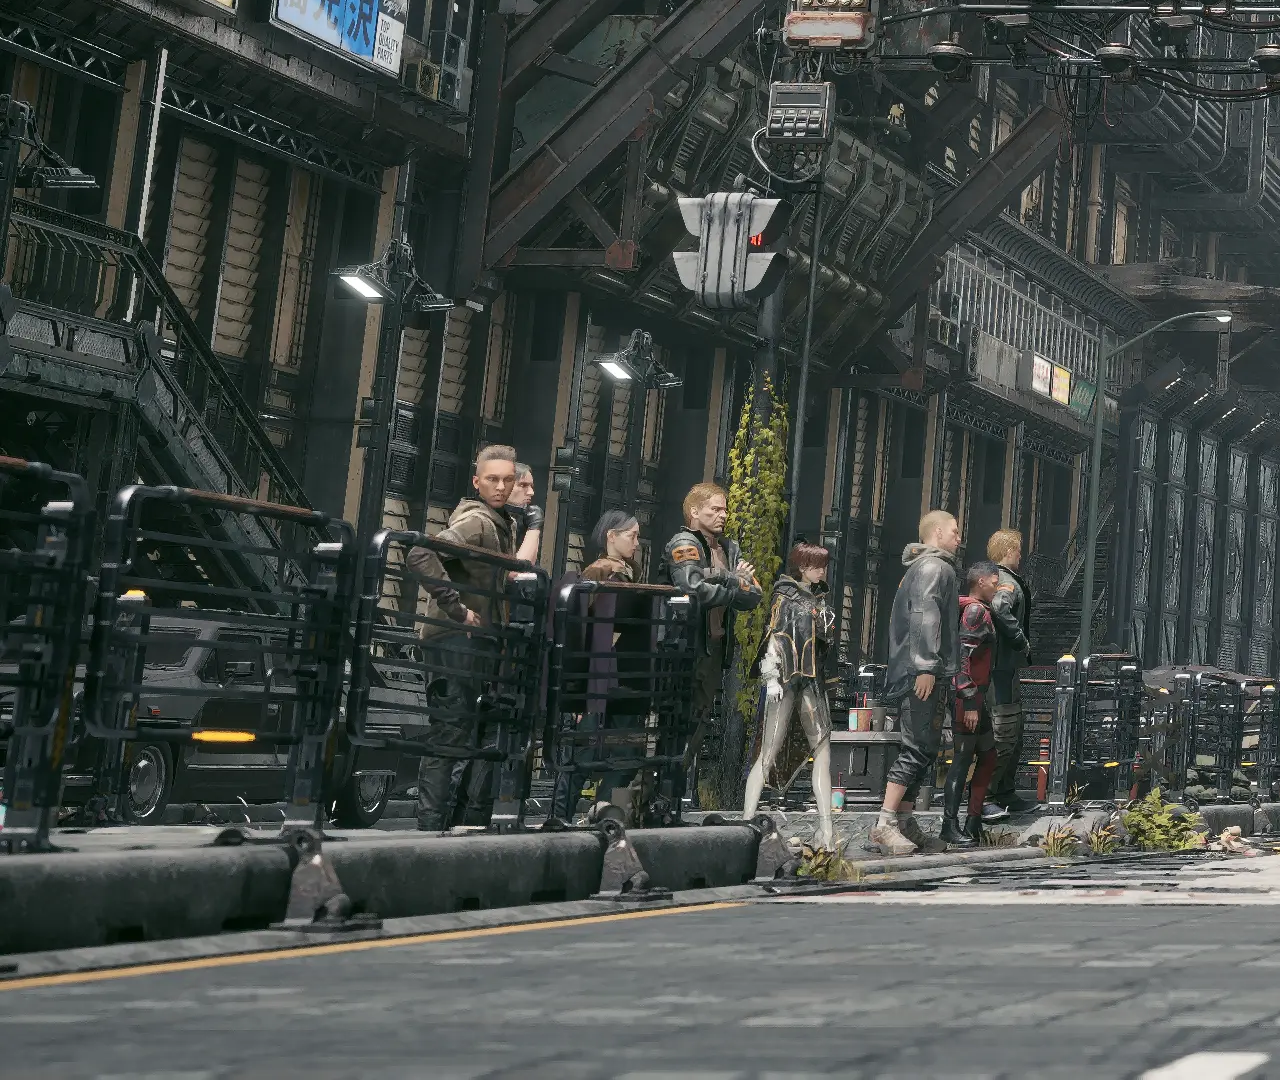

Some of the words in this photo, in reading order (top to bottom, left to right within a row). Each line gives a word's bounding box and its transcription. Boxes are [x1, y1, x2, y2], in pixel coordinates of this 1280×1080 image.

[380, 19, 391, 33] TOP
[379, 33, 400, 52] QUALITY
[377, 47, 393, 65] PARTS
